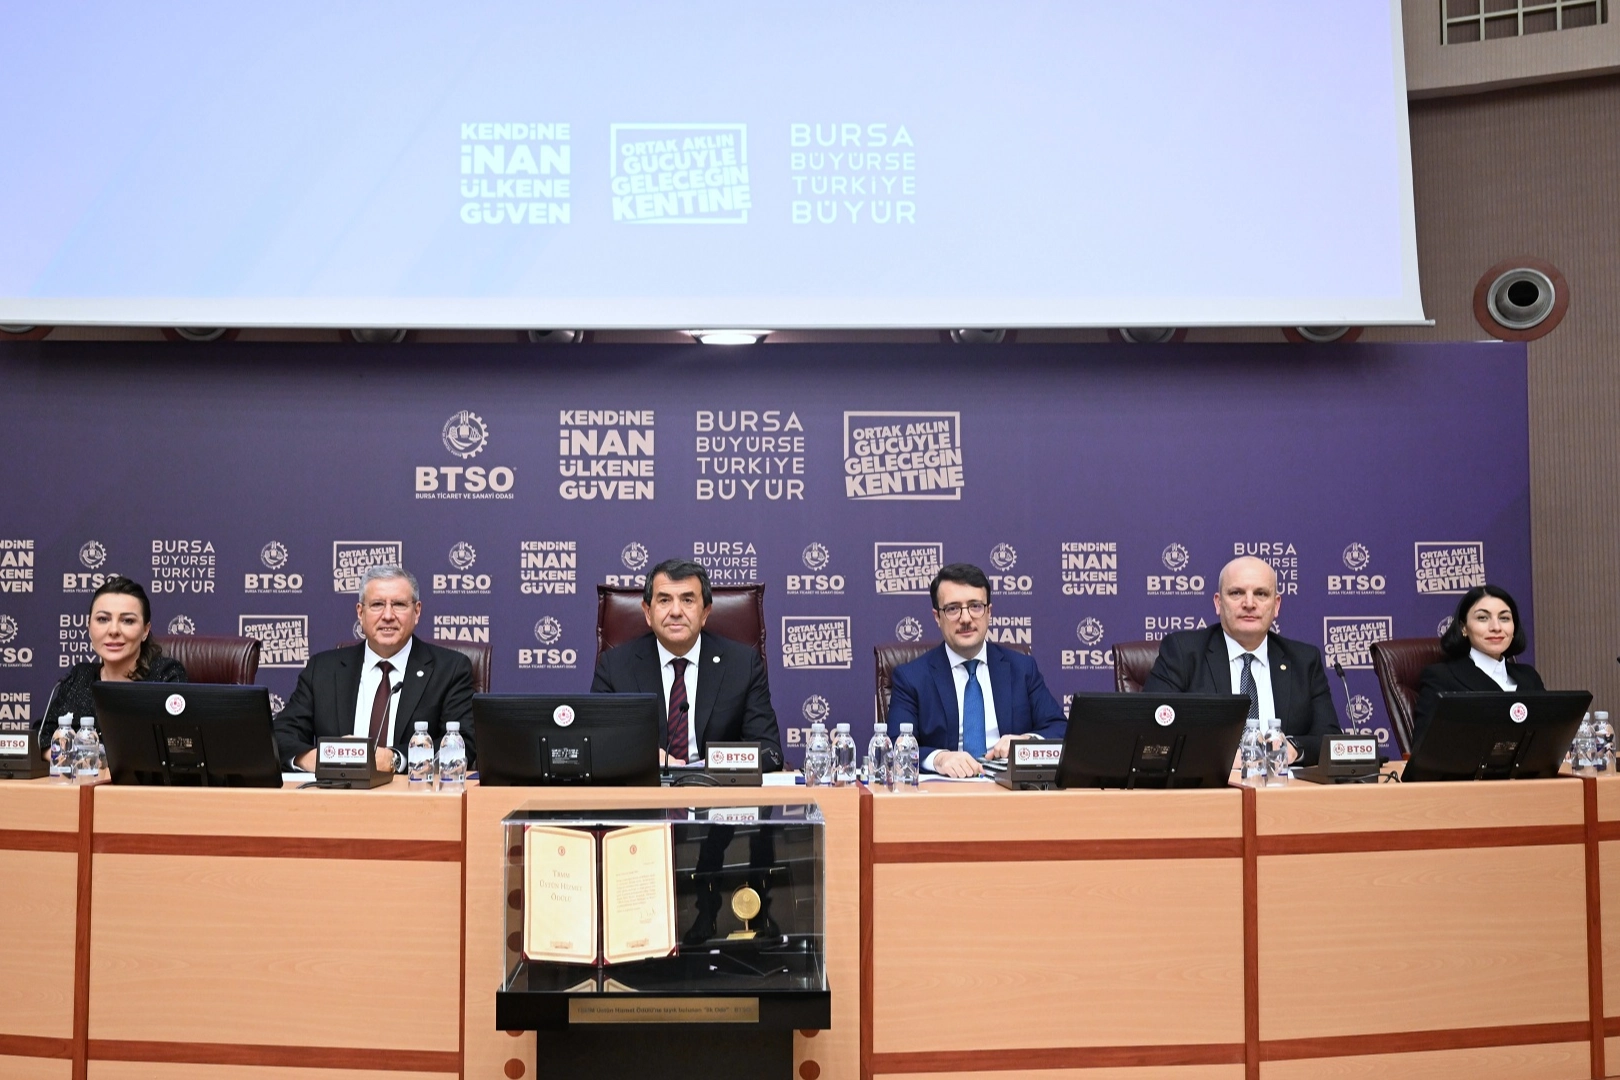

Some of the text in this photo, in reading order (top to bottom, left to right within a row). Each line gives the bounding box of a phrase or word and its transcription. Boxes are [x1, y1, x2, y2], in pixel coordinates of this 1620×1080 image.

[791, 123, 914, 147] BURSA
[621, 133, 734, 156] ORTAK AKLIN
[791, 152, 915, 170] BÜYÜRSE
[792, 200, 916, 224] BÜYÜR
[696, 411, 804, 432] BURSA
[853, 420, 949, 440] ORTAK AKLIN
[696, 436, 804, 453] BÜYÜRSE
[415, 466, 514, 492] BTSO
[696, 479, 804, 500] BÜYÜR
[152, 540, 215, 553] BURSA
[338, 546, 396, 559] ORTAK AKLIN
[693, 542, 757, 555] BURSA
[880, 547, 937, 560] ORTAK AKLIN
[1234, 542, 1297, 555] BURSA
[1420, 546, 1477, 560] ORTAK AKLIN
[152, 555, 216, 565] BÜYÜRSE
[244, 573, 303, 589] BTSO
[706, 569, 757, 579] ÜRKİYE
[151, 580, 215, 593] BÜYÜR
[433, 574, 491, 590] BTSO
[786, 575, 845, 590] BTSO
[988, 576, 1032, 591] TSO
[1147, 575, 1205, 591] BTSO
[1327, 575, 1386, 590] BTSO
[245, 620, 301, 633] ORTAK AKLIN
[787, 621, 844, 634] ORTAK AKLIN
[1145, 616, 1208, 630] BURSA
[1329, 621, 1386, 634] ORTAK AKLIN
[985, 628, 1032, 644] NAN
[518, 649, 577, 665] BTSO
[0, 740, 25, 748] BTSO
[1347, 745, 1373, 753] BTSO
[338, 748, 365, 756] BTSO
[726, 753, 755, 761] BTSO
[1032, 750, 1060, 758] BTSO
